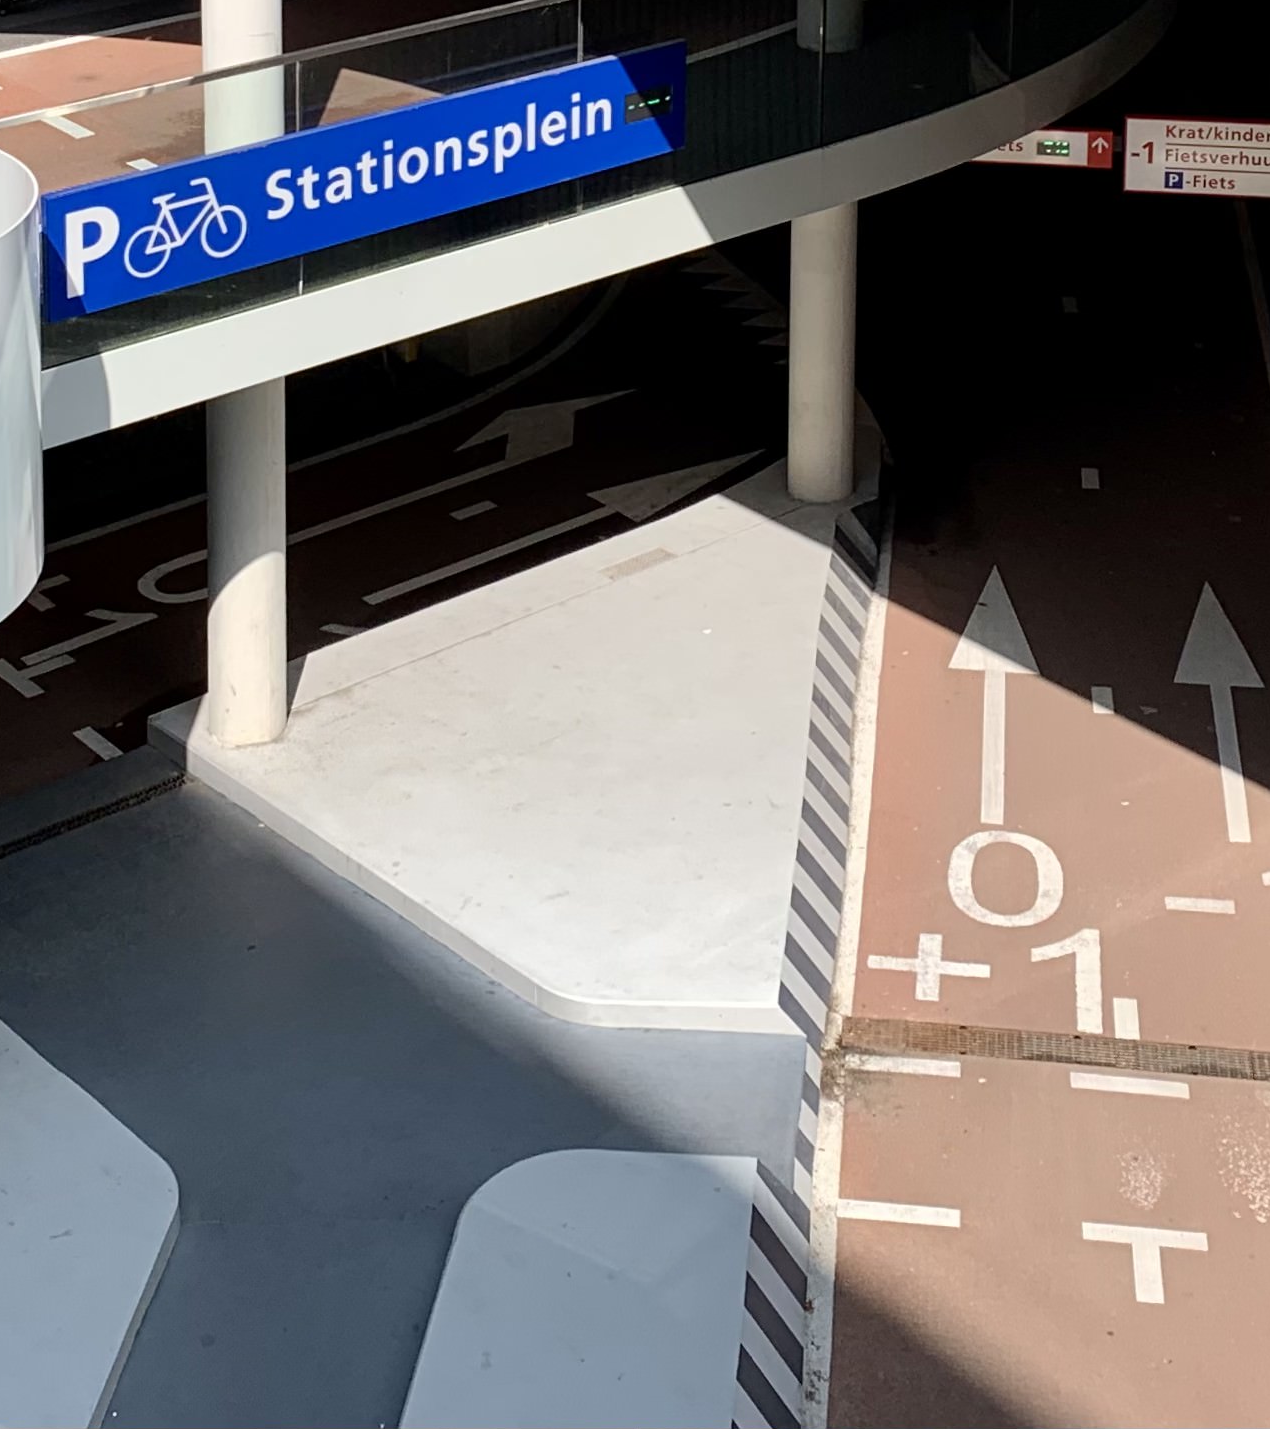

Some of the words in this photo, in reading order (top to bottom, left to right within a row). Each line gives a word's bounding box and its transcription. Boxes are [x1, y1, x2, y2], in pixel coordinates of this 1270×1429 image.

[64, 205, 120, 299] P
[263, 92, 613, 221] Stationsplein
[1130, 141, 1155, 165] -1
